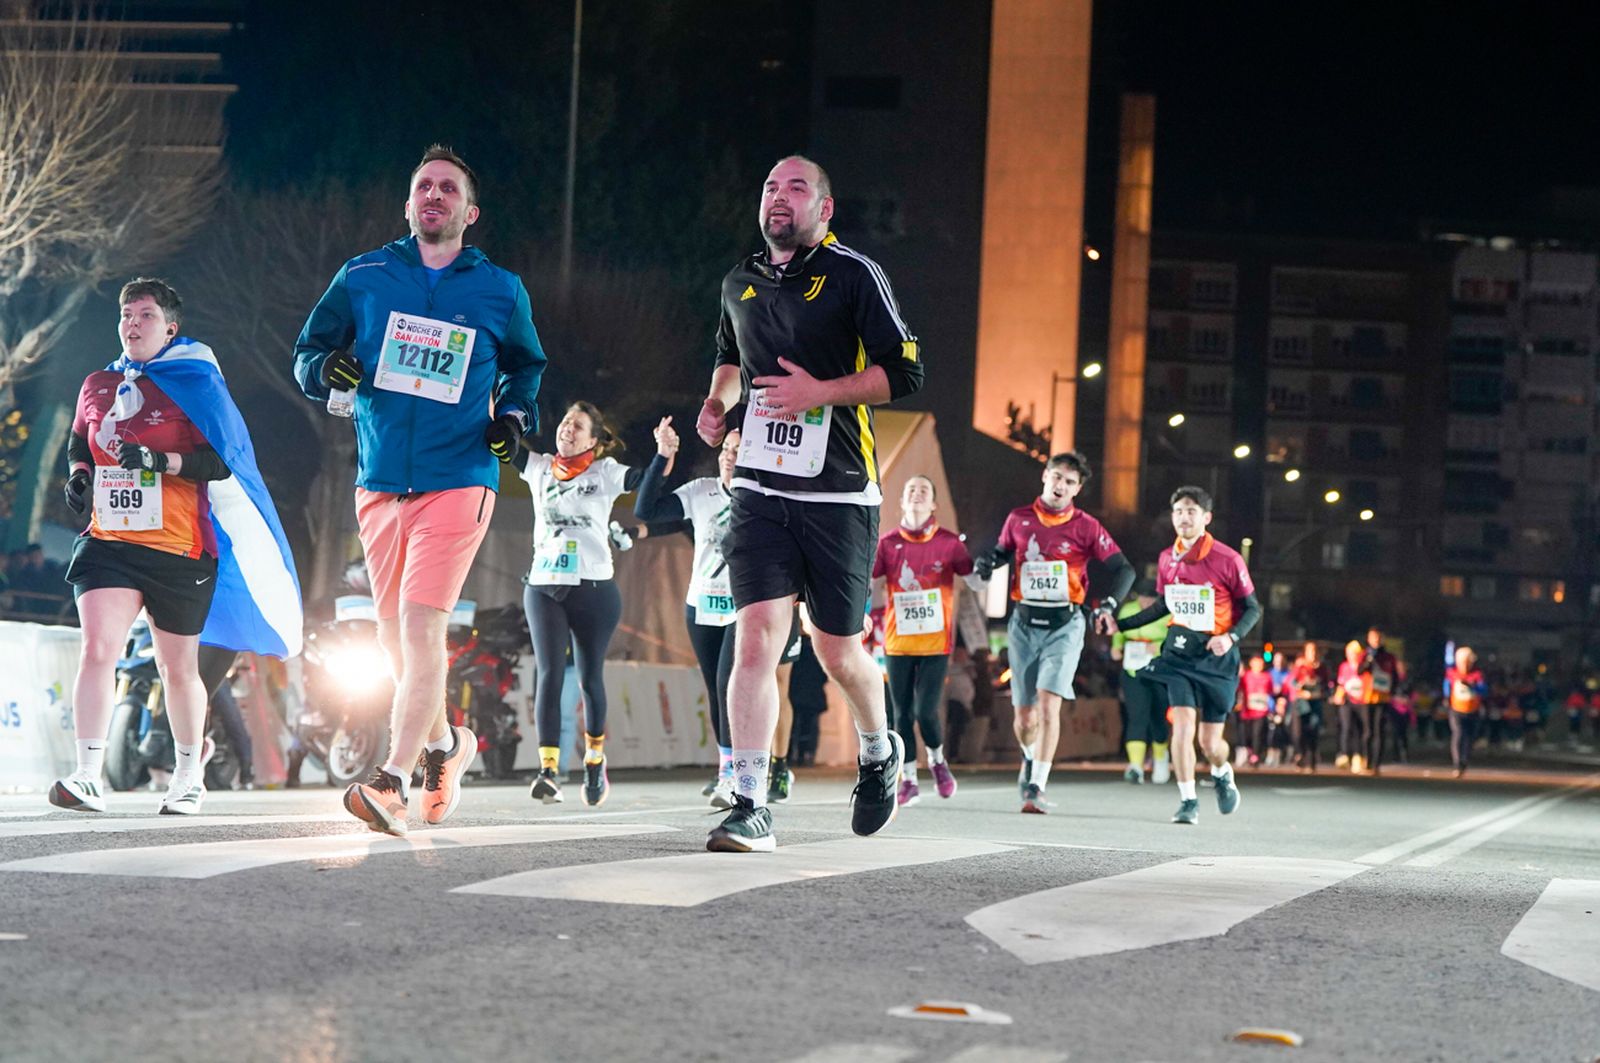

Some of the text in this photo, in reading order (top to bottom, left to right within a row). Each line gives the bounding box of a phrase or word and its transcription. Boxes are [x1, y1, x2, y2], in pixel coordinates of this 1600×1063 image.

[394, 331, 411, 343] SAN
[406, 324, 431, 336] NOCHE
[432, 329, 442, 338] DE
[398, 343, 454, 376] 12112
[765, 421, 803, 448] 109
[101, 480, 113, 488] SAN
[109, 489, 143, 508] 569
[1030, 577, 1059, 590] 2642
[707, 595, 735, 610] 7751
[1174, 601, 1205, 614] 5398
[904, 606, 934, 620] 2595
